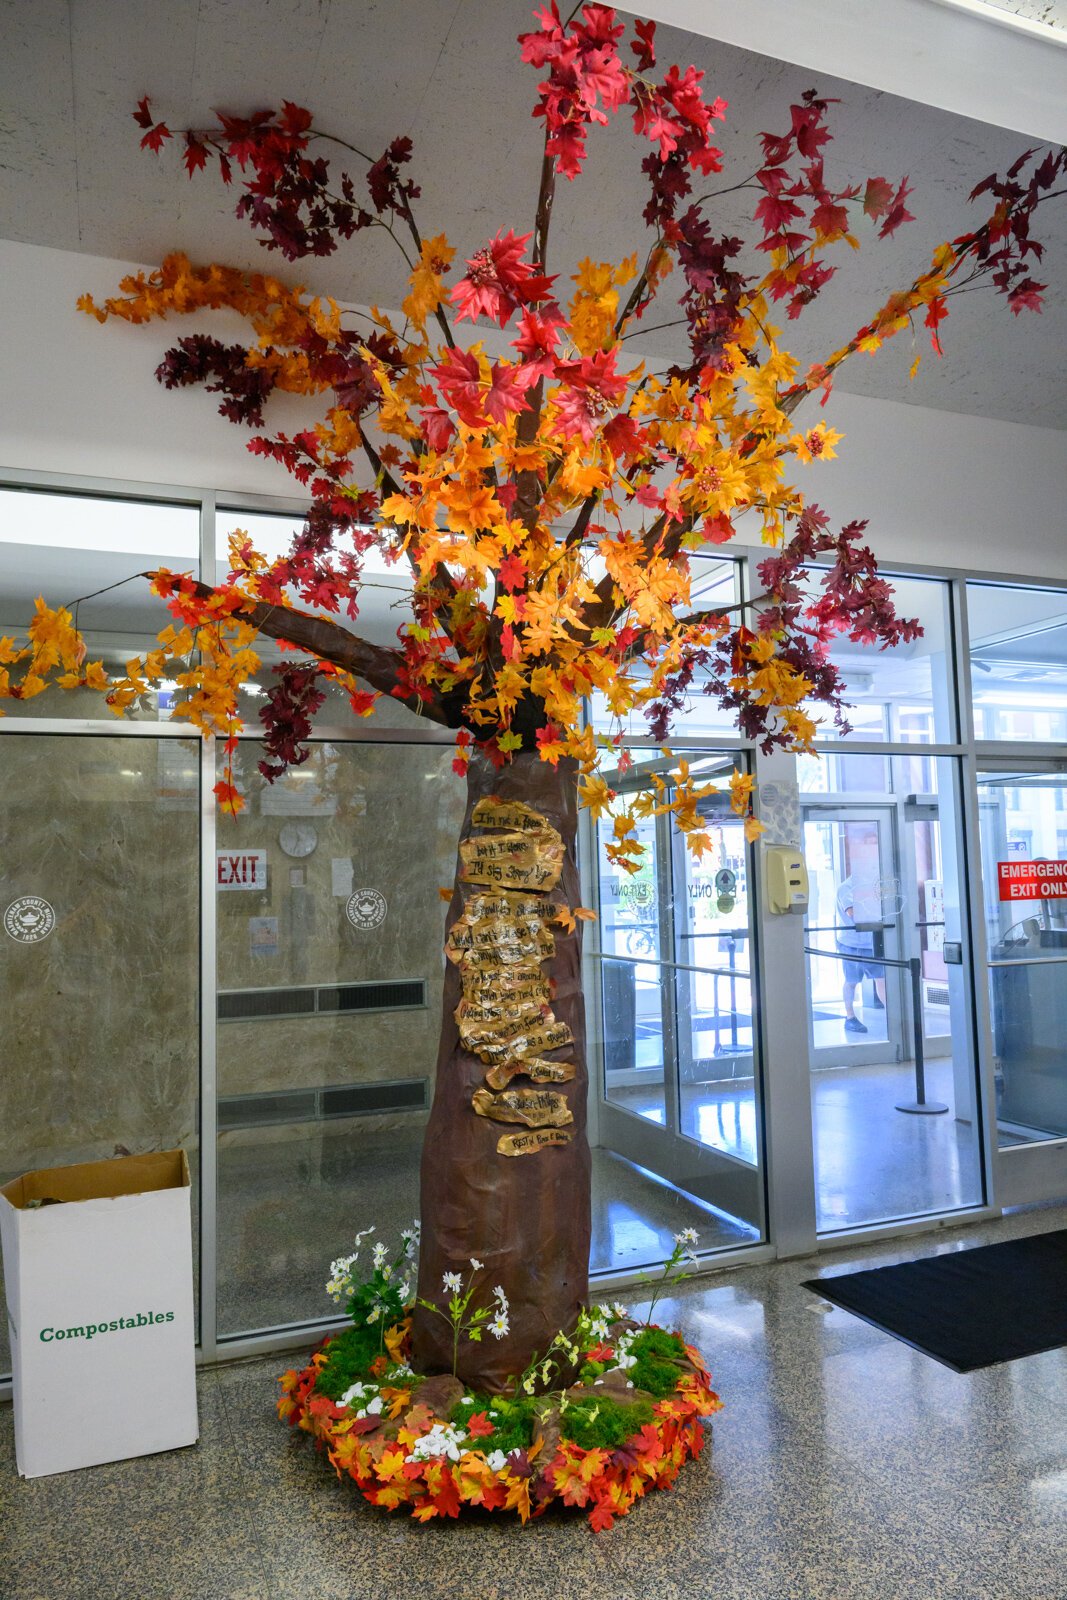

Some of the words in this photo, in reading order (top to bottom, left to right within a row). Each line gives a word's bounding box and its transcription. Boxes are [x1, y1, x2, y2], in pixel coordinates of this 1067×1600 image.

[217, 856, 259, 884] EXIT
[1010, 884, 1038, 897] EXIT
[39, 1311, 175, 1343] Compostables
